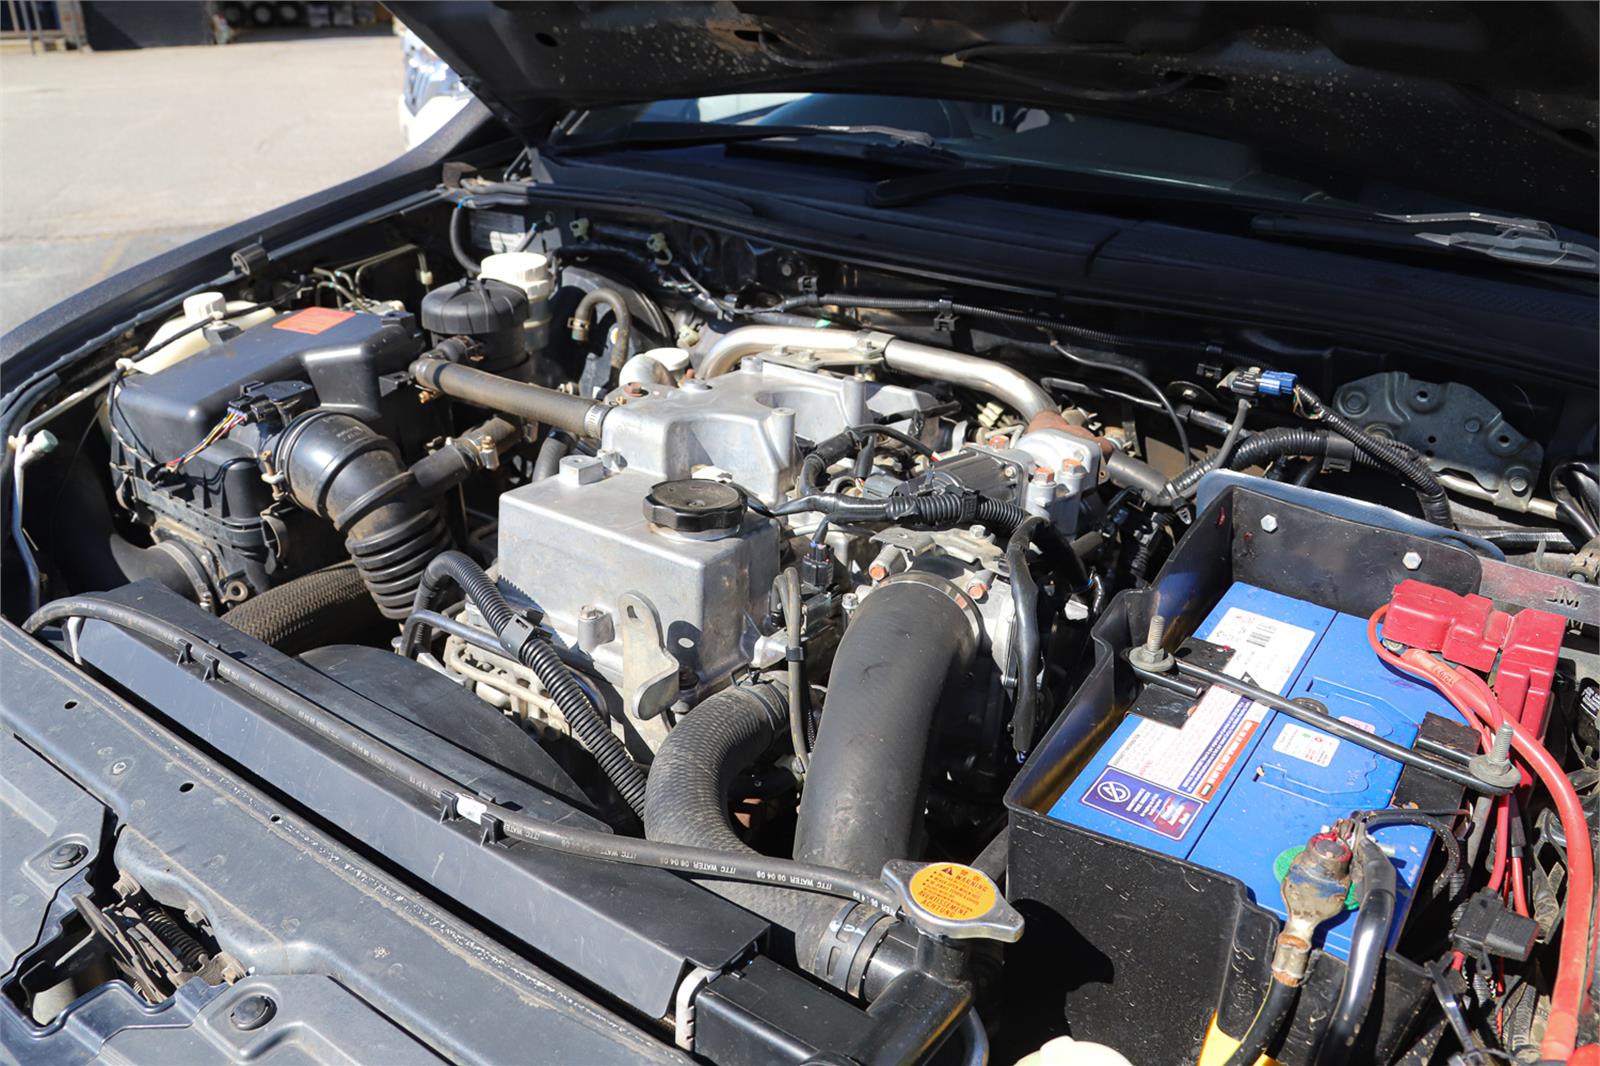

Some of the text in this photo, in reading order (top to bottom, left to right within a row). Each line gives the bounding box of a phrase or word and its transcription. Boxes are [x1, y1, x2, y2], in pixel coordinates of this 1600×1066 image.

[692, 861, 718, 871] WATER
[789, 876, 814, 887] WATER
[956, 874, 988, 892] WARNING
[922, 899, 956, 918] ACHTUNG
